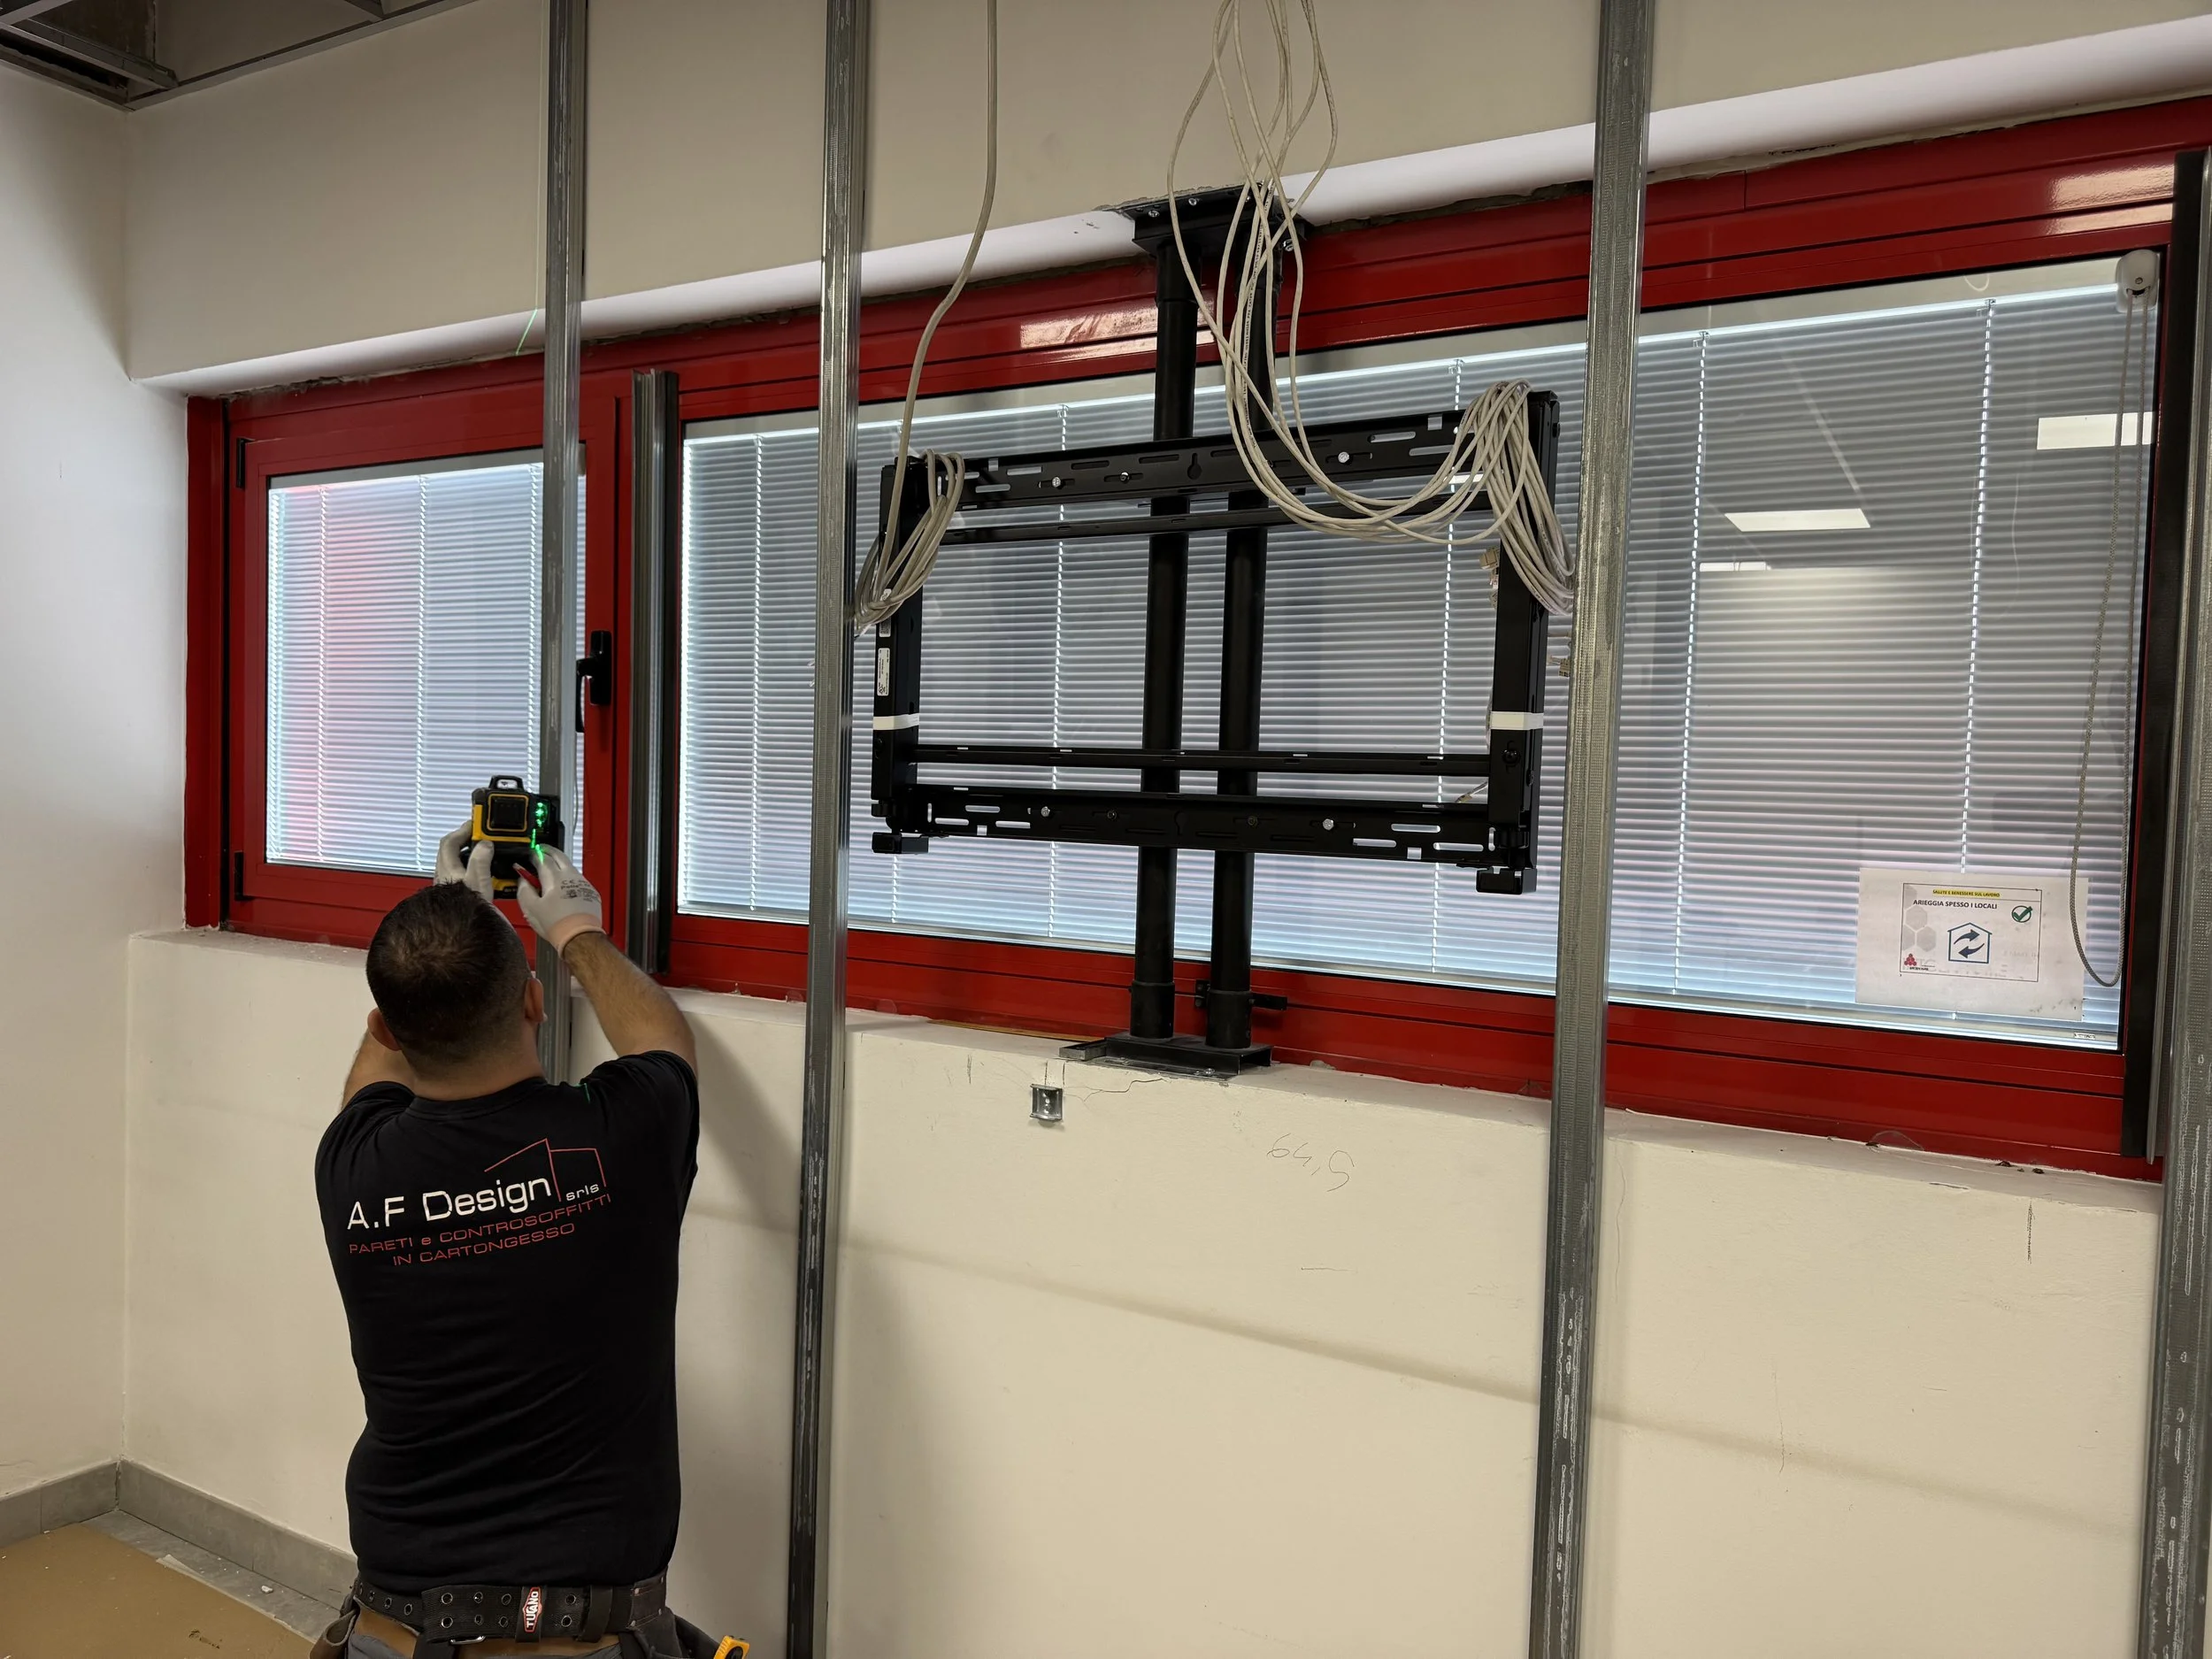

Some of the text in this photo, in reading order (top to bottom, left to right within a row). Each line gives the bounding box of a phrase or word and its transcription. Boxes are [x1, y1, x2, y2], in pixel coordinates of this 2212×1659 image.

[347, 1178, 600, 1230] A.F Design srls
[349, 1193, 611, 1254] PARETI e CONTROSOFFITTI
[393, 1222, 575, 1266] IN CARTONGESSO
[526, 1591, 539, 1628] TUCANO
